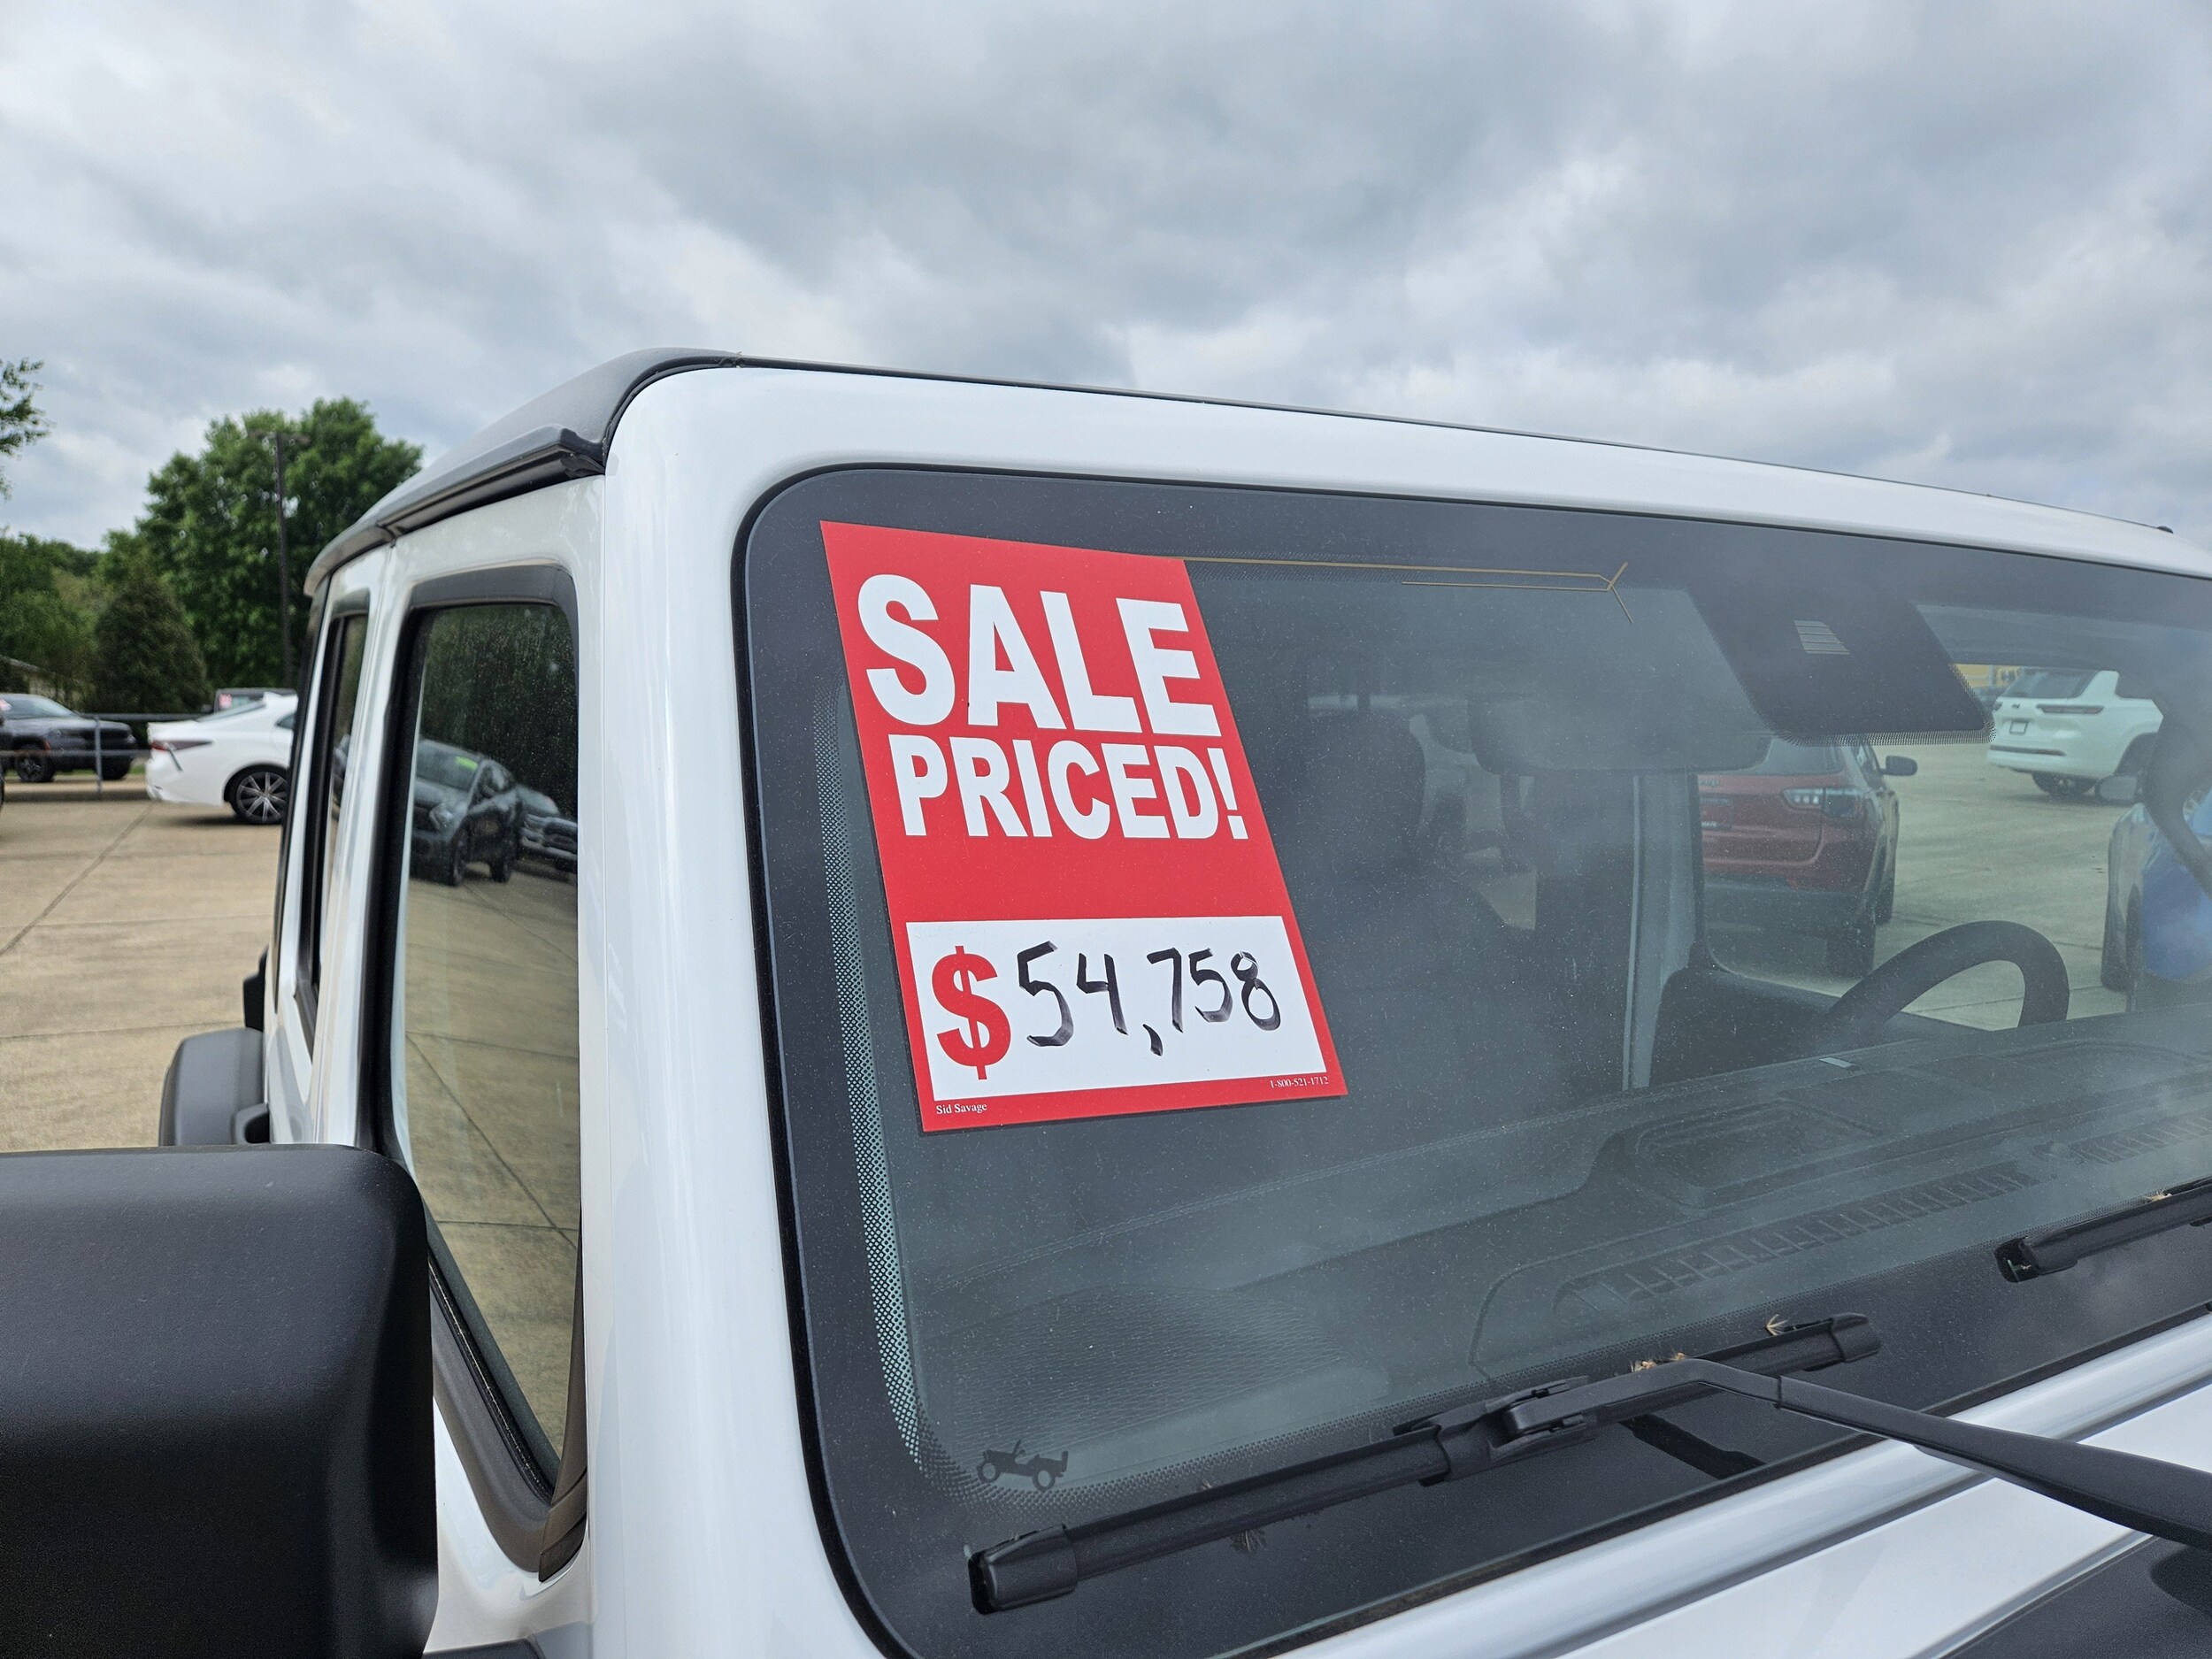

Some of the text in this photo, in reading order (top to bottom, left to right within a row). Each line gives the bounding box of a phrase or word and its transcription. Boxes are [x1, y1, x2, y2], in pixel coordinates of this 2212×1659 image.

[858, 574, 1222, 736] SALE
[888, 734, 1249, 840] PRICED!
[936, 1103, 987, 1115] Sid Savage
[1270, 1076, 1329, 1088] 1-800-521-1712
